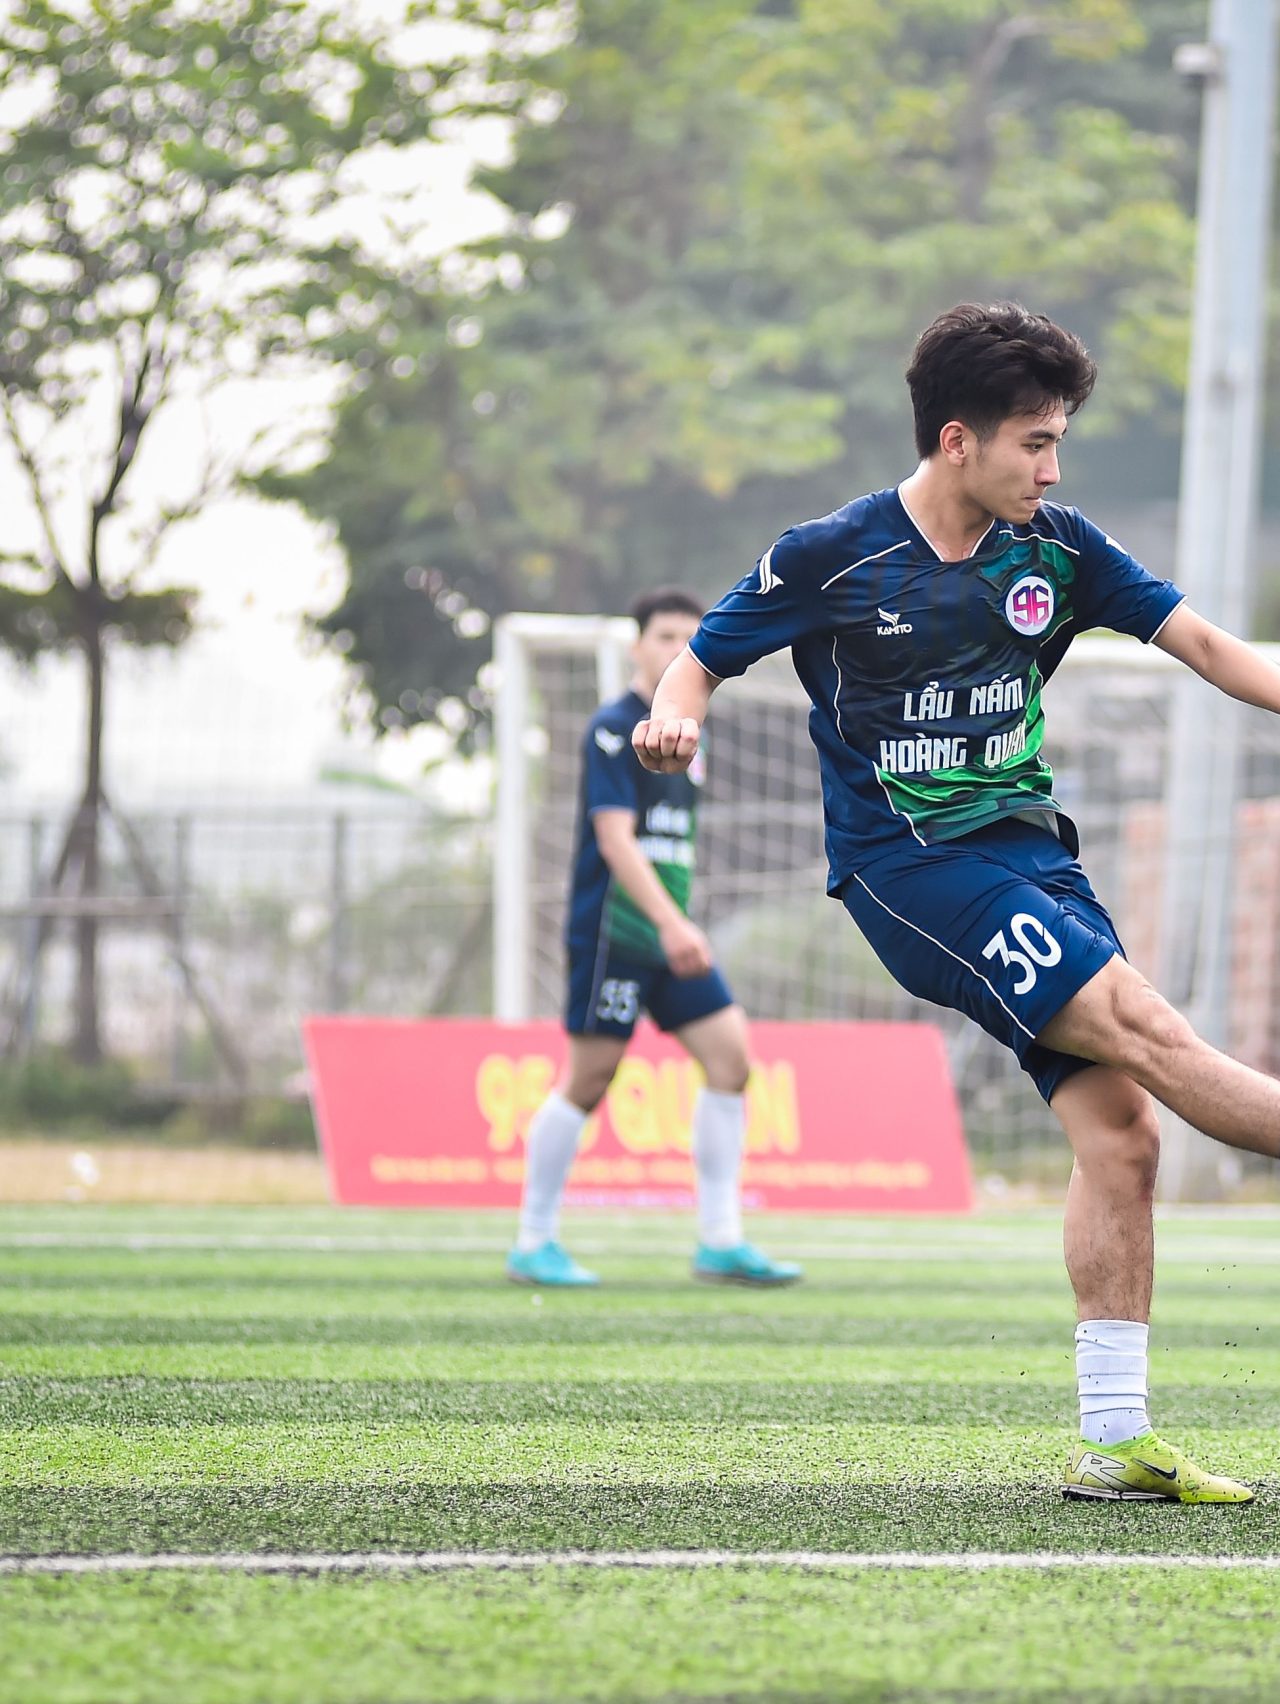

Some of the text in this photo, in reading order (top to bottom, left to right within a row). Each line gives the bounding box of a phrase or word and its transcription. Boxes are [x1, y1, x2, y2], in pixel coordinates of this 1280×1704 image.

[1013, 584, 1049, 628] 96
[903, 673, 1024, 721] LẨU NẤM
[880, 732, 967, 774] HOÀNG
[981, 912, 1062, 995] 30
[607, 1056, 800, 1154] QUN
